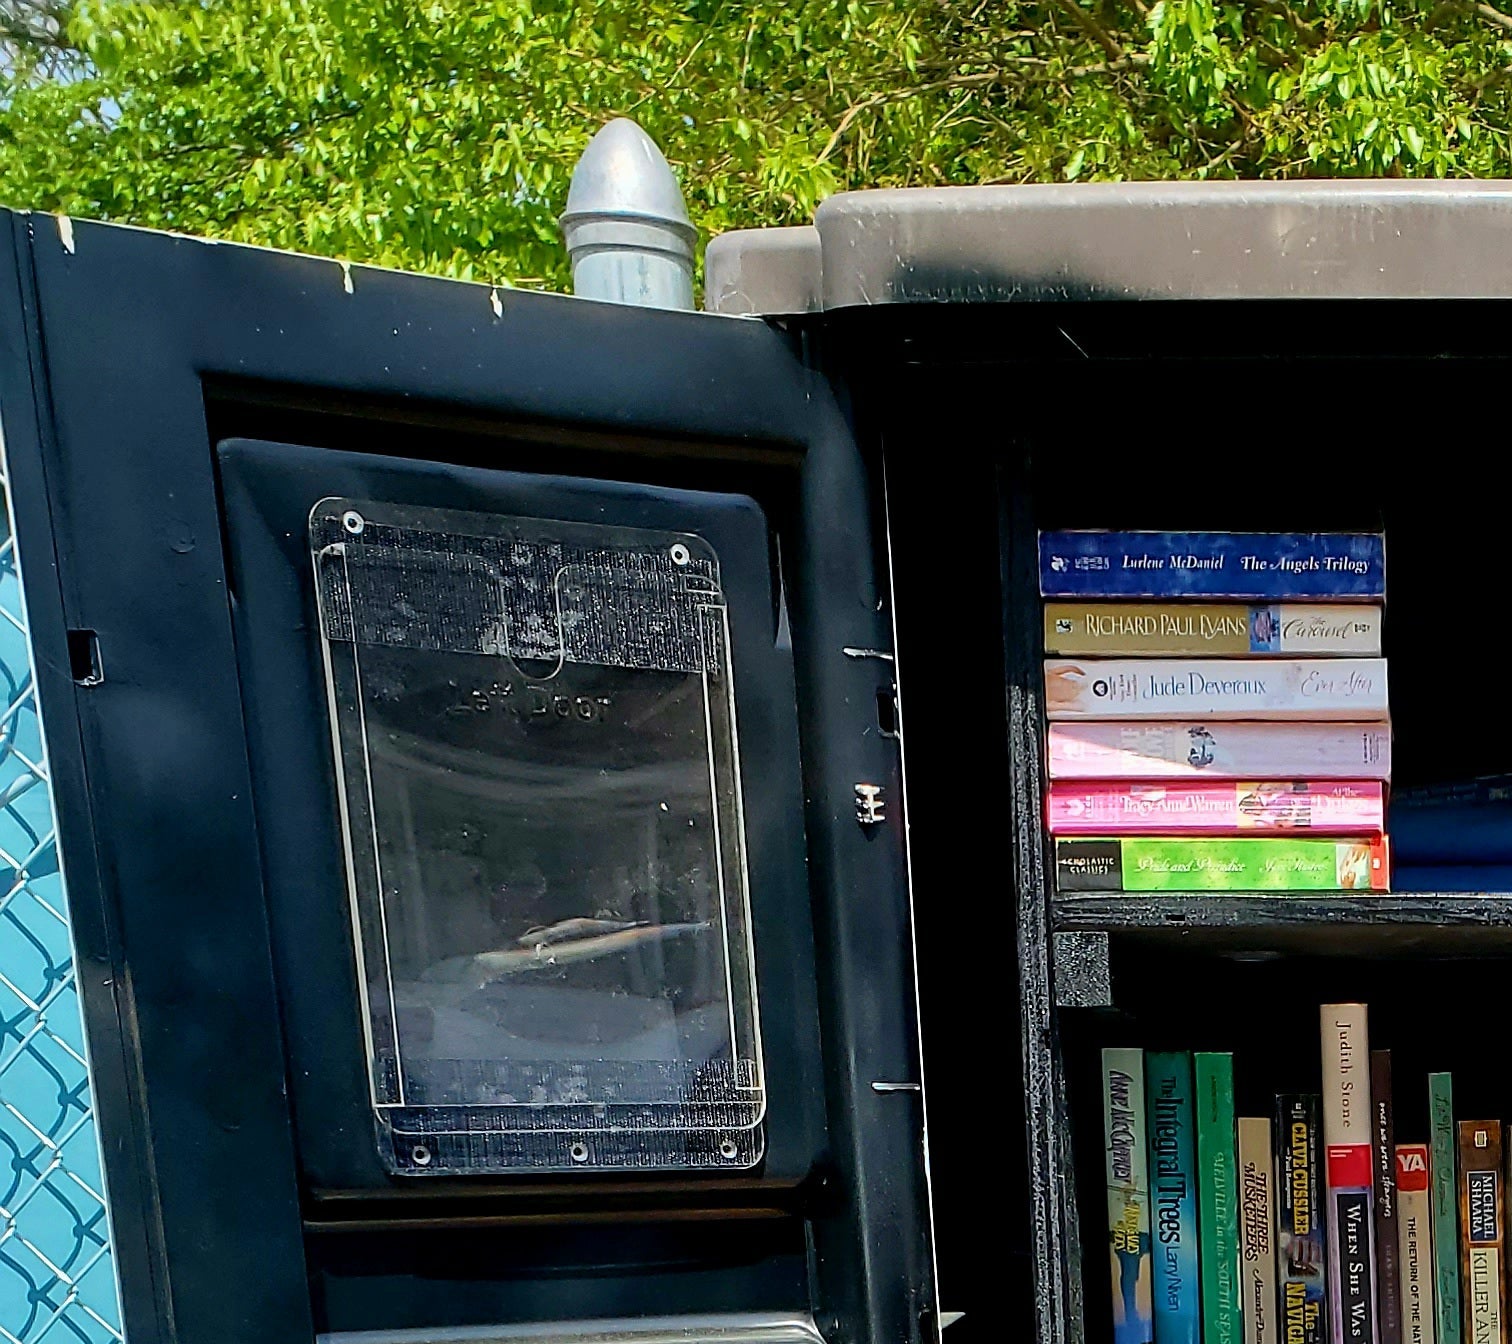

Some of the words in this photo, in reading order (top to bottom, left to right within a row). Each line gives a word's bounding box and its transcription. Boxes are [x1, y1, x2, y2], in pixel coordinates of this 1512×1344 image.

[1123, 555, 1164, 569] Lurlene
[1170, 554, 1223, 569] McDaniel
[1241, 556, 1266, 570] The
[1271, 558, 1319, 573] Angels
[1323, 558, 1369, 574] Trilogy
[1085, 614, 1157, 636] RICHARD
[1160, 614, 1198, 635] PAUL
[1201, 616, 1246, 640] EVANS
[1143, 675, 1185, 699] Jude
[1189, 672, 1266, 696] Deveraux
[1162, 1078, 1178, 1097] The
[1154, 1097, 1186, 1178] Integral
[1292, 1122, 1306, 1168] CLIVE
[1159, 1180, 1188, 1243] Trees
[1292, 1169, 1308, 1235] CUSSLER
[1471, 1179, 1483, 1234] SHAARA
[1482, 1176, 1494, 1238] MICHAEL
[1346, 1205, 1360, 1255] WHEN
[1407, 1217, 1417, 1238] THE
[1408, 1241, 1419, 1282] RETURN
[1349, 1262, 1363, 1295] SHE
[1409, 1285, 1420, 1299] OF
[1305, 1303, 1319, 1329] The
[1351, 1302, 1364, 1336] WAS
[1410, 1302, 1420, 1321] THE
